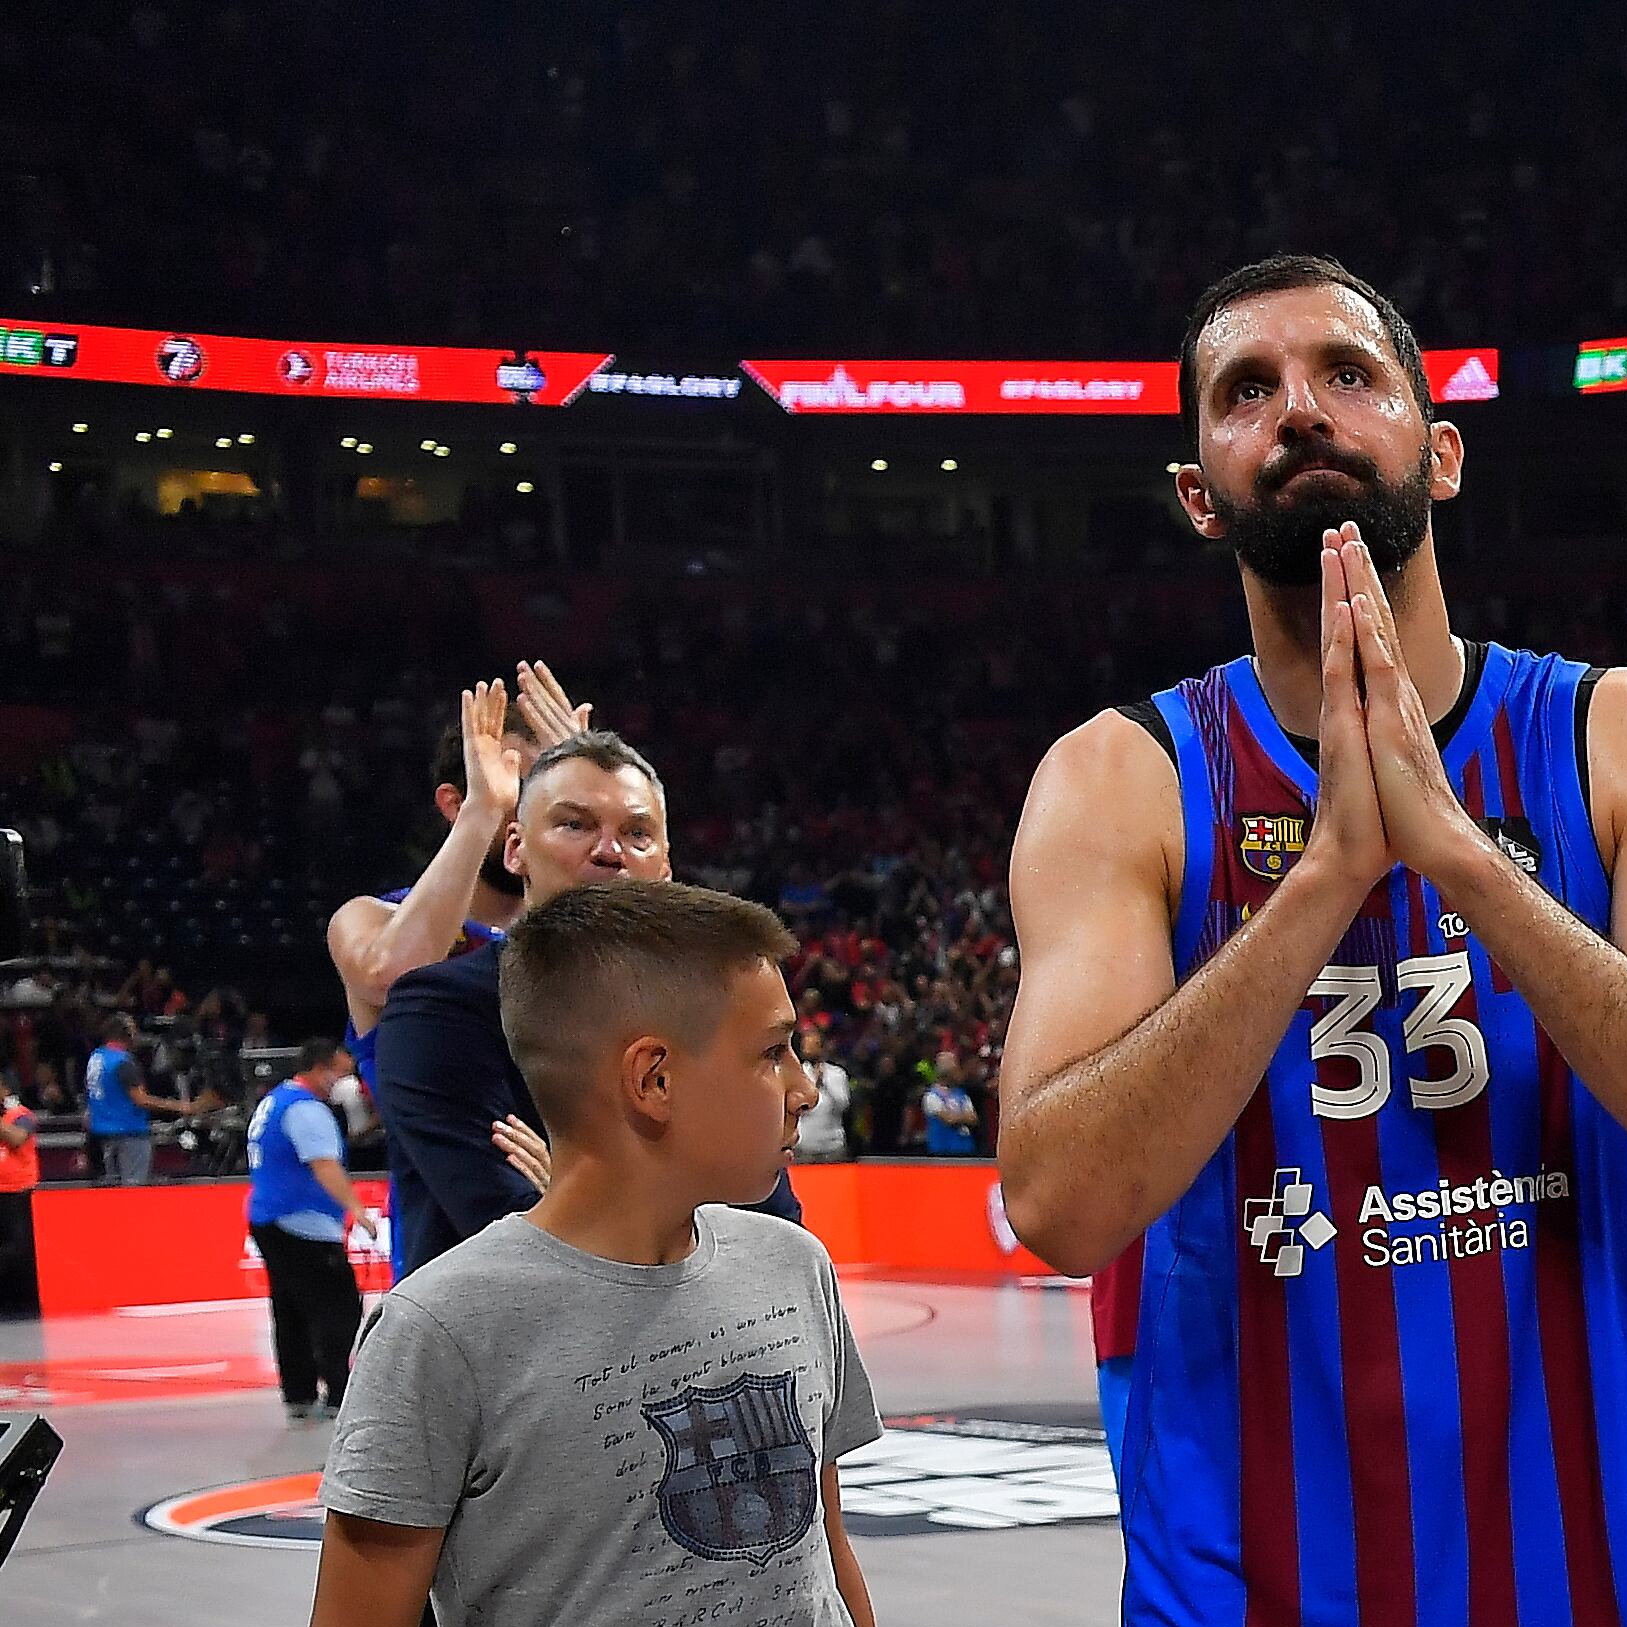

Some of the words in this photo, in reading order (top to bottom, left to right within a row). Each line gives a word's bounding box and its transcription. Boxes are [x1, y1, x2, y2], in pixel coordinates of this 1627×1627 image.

[322, 370, 420, 393] AIRLINES
[323, 350, 418, 373] TURKISH
[1306, 950, 1490, 1120] 33
[1358, 1163, 1570, 1224] Assistènia
[1361, 1212, 1530, 1267] Sanitària
[574, 1366, 613, 1393] Tot
